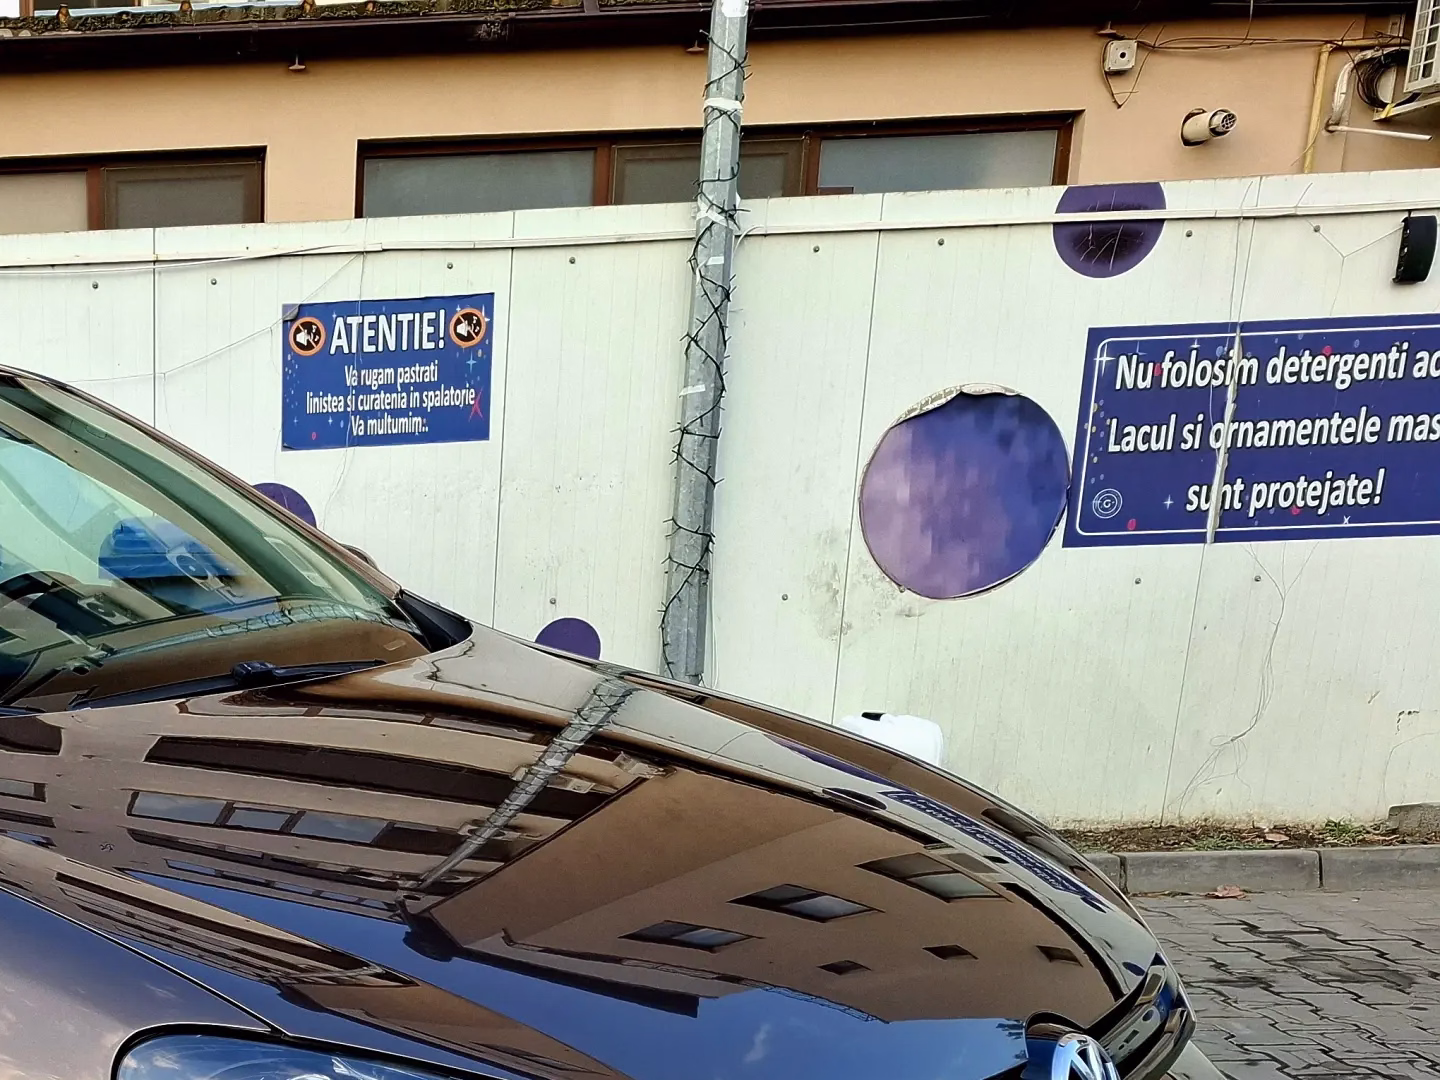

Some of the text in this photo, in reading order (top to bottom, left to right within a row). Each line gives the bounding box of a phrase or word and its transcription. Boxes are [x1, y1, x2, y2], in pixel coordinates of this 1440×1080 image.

[329, 309, 447, 355] ATENTIE!
[345, 360, 439, 392] Va rugam pastrati
[1115, 354, 1154, 390] Nu
[1160, 347, 1259, 389] folosim
[1266, 342, 1408, 391] detergenti
[306, 383, 476, 415] linistea si curatenia in spalatorie
[351, 414, 365, 436] Va
[1107, 413, 1178, 453] Lacul
[1180, 413, 1205, 450] si
[1210, 406, 1382, 450] ornamentele
[1185, 468, 1387, 518] sunt protejate!
